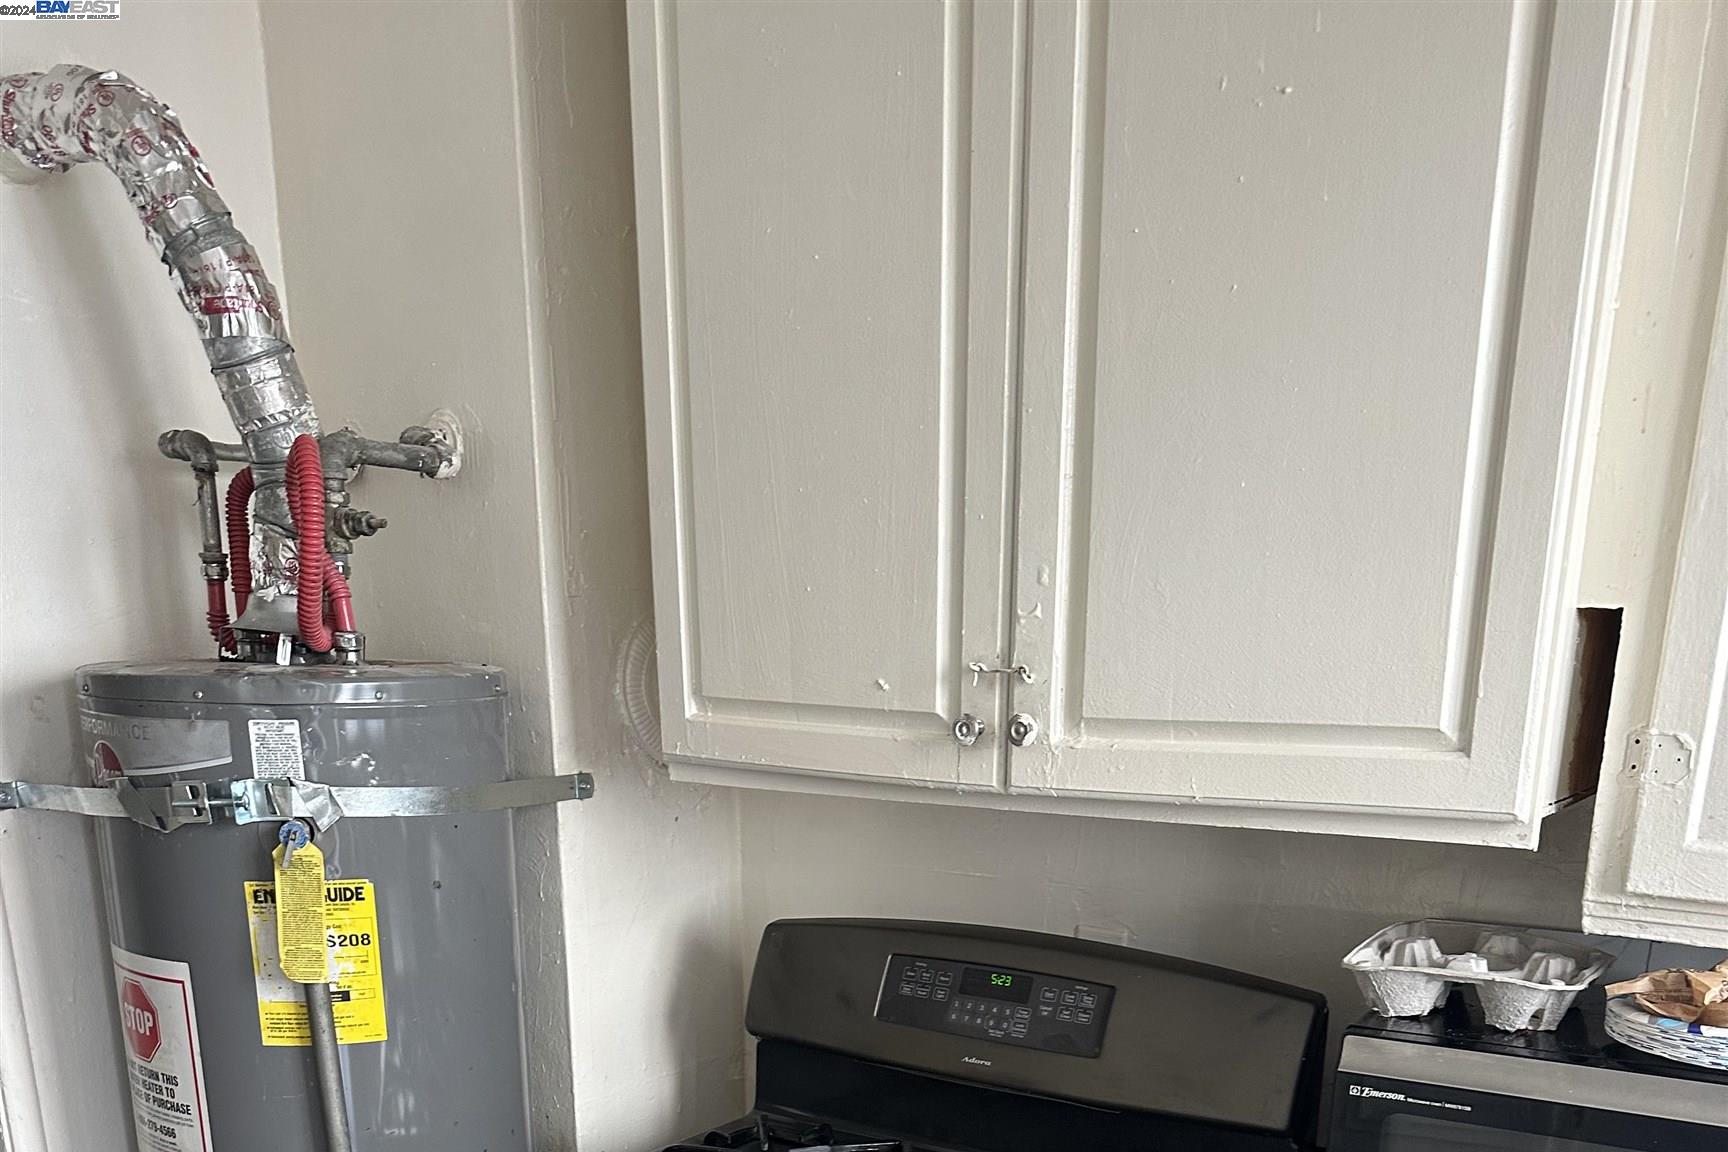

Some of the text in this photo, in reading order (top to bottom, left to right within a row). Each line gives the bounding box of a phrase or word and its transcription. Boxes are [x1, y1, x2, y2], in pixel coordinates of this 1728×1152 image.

[991, 973, 1013, 987] 5:23
[124, 1002, 153, 1036] STOP
[961, 1056, 992, 1067] Adora
[160, 1072, 179, 1087] THIS
[164, 1086, 176, 1099] TO
[1361, 1086, 1405, 1101] Emerson
[152, 1095, 192, 1116] PURCHASE
